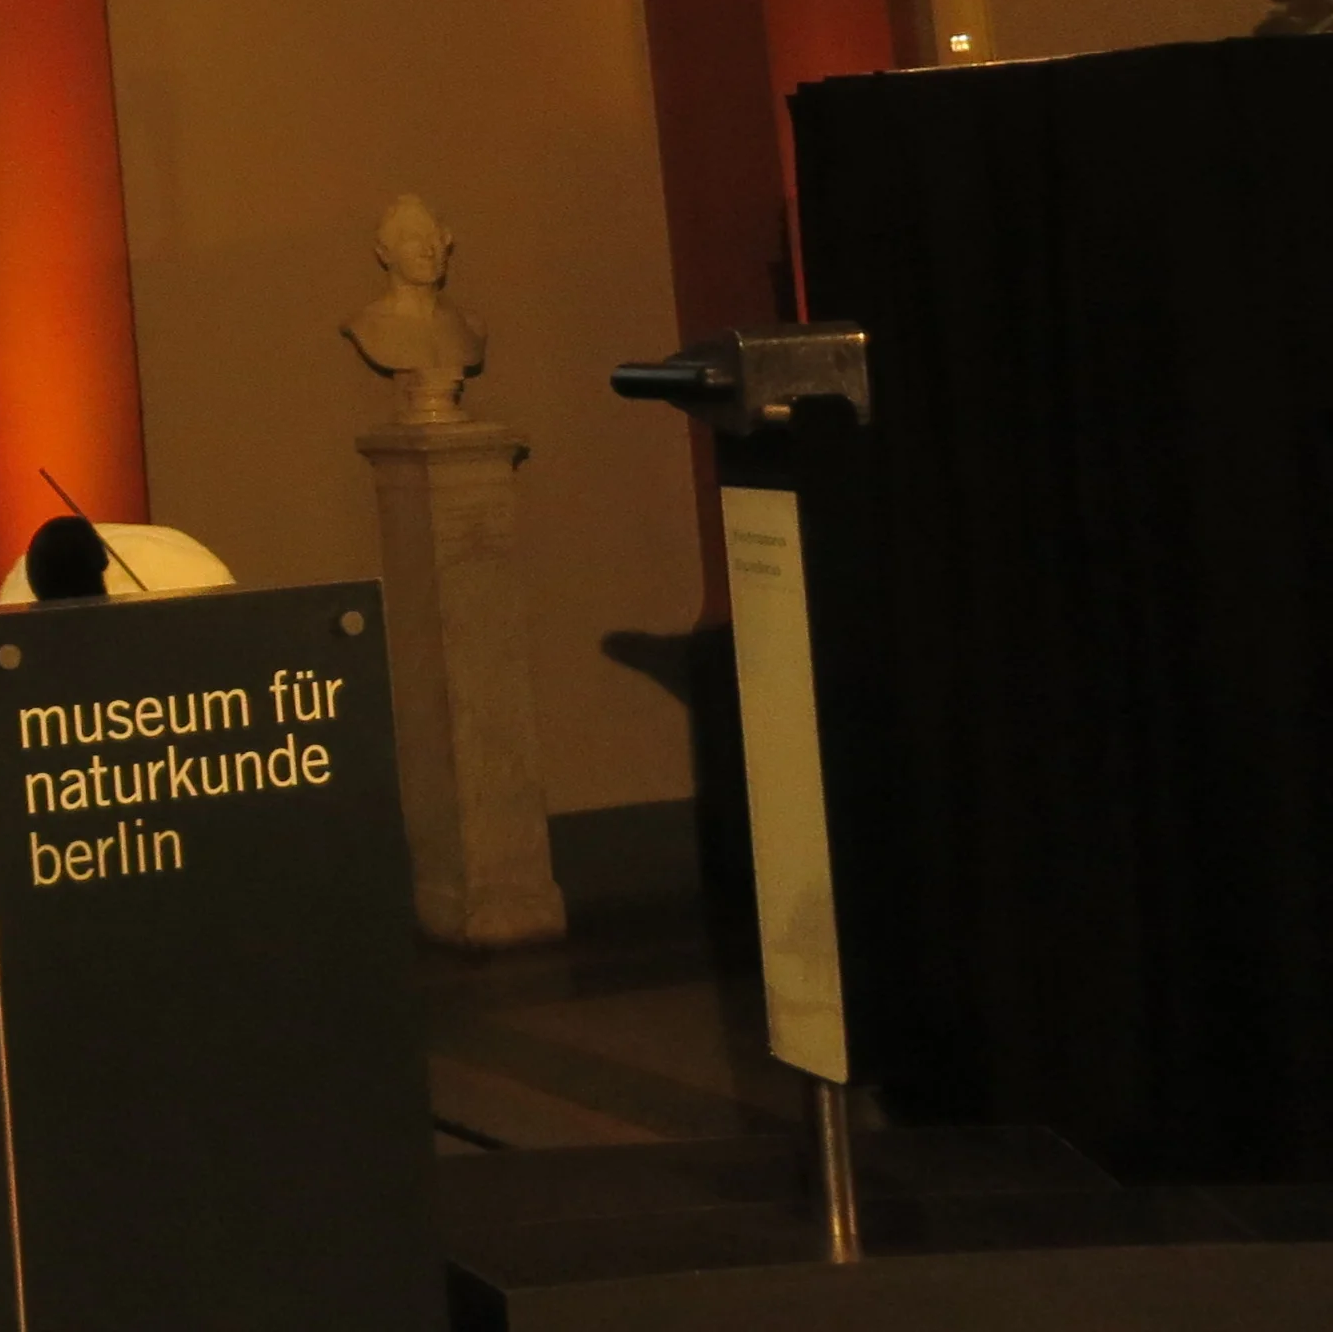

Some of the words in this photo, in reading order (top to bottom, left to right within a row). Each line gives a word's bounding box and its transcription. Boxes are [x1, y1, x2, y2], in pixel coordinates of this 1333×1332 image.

[18, 686, 251, 750] museum
[269, 669, 344, 724] für
[24, 732, 332, 815] naturkunde
[29, 818, 184, 888] berlin
